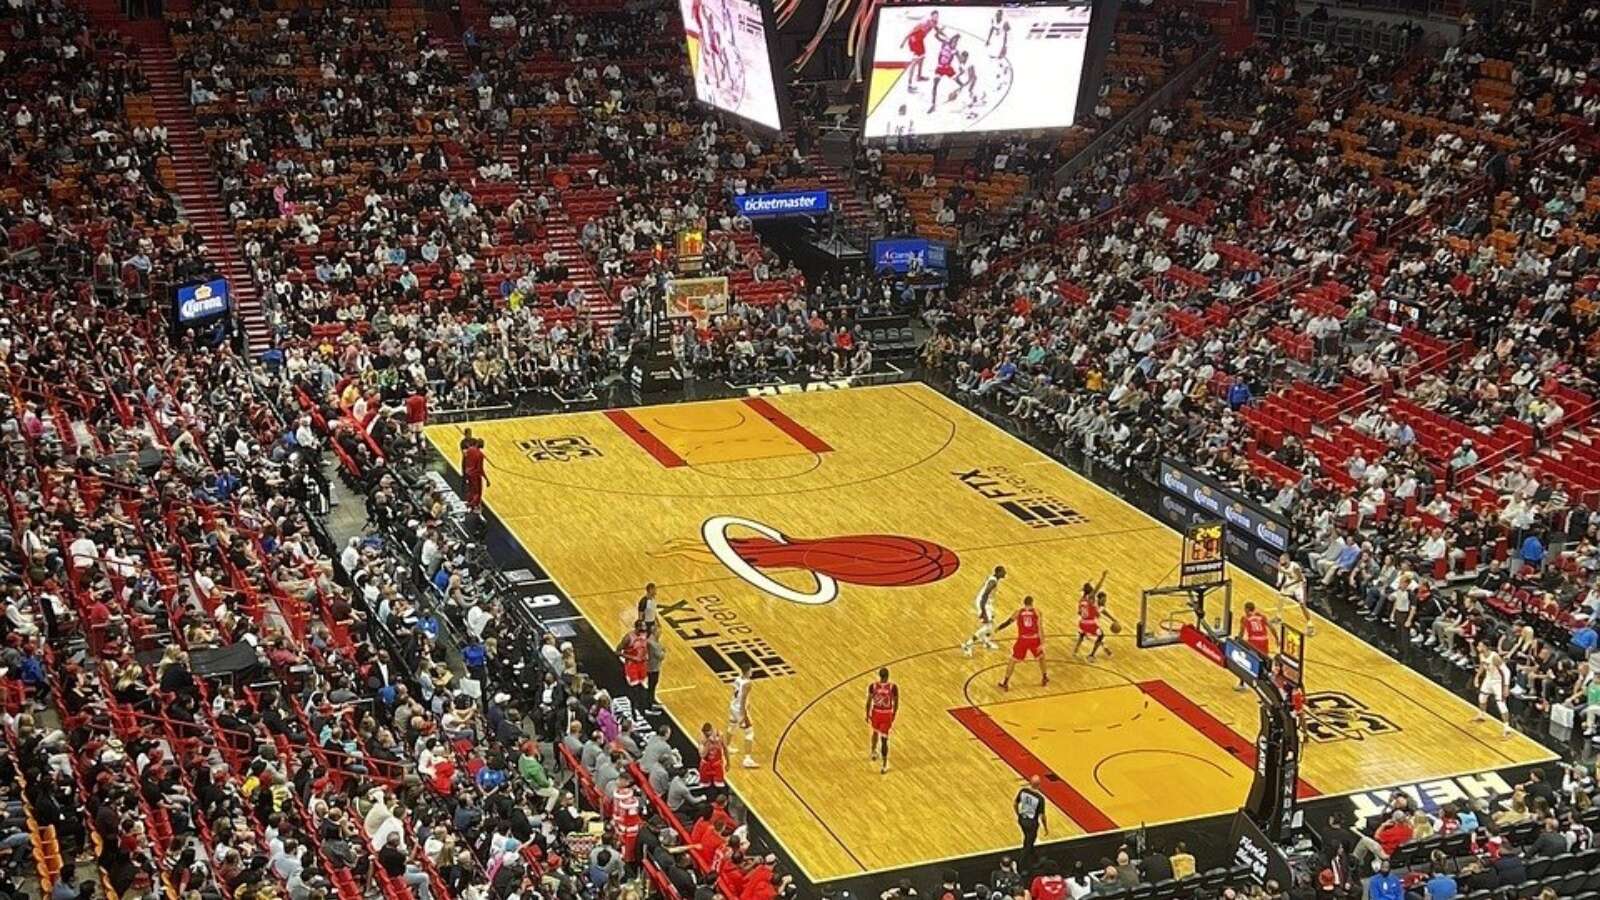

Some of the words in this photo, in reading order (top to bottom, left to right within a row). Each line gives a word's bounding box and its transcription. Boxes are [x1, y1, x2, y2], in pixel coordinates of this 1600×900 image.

[744, 196, 817, 211] ticketmaster
[182, 296, 224, 317] Corona
[951, 469, 1017, 499] FTX
[987, 465, 1043, 494] arena
[656, 599, 720, 641] FTX
[695, 594, 753, 637] arena
